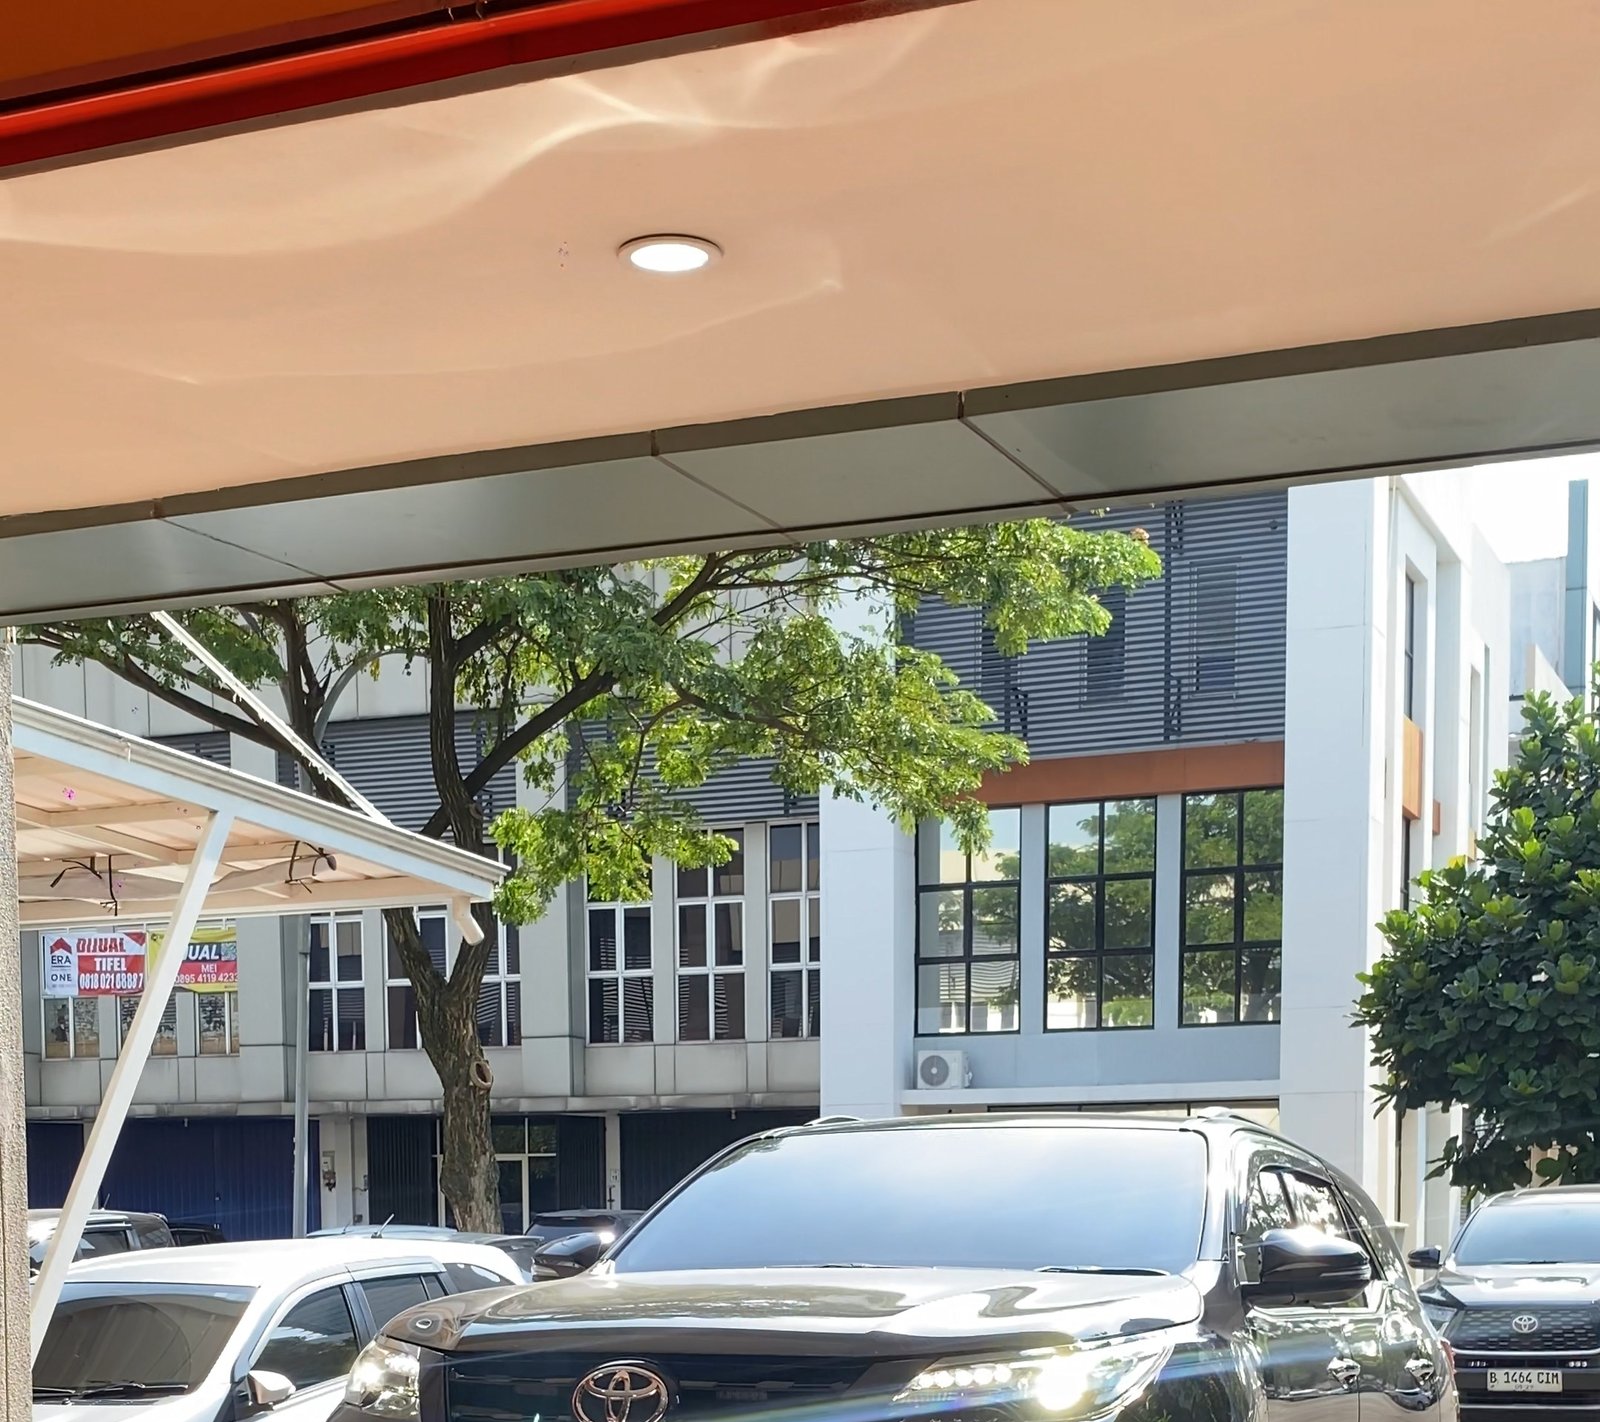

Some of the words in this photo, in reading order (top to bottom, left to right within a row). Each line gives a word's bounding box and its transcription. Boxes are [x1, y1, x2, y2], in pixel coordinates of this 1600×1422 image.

[183, 944, 220, 960] UAL
[51, 955, 72, 965] ERA
[94, 957, 127, 971] TIFEL
[201, 964, 217, 973] MEI
[51, 973, 72, 982] ONE
[100, 973, 114, 989] 021
[197, 973, 217, 983] 4119
[1490, 1372, 1497, 1383] B
[1504, 1372, 1532, 1384] 1464
[1537, 1372, 1559, 1384] CIM
